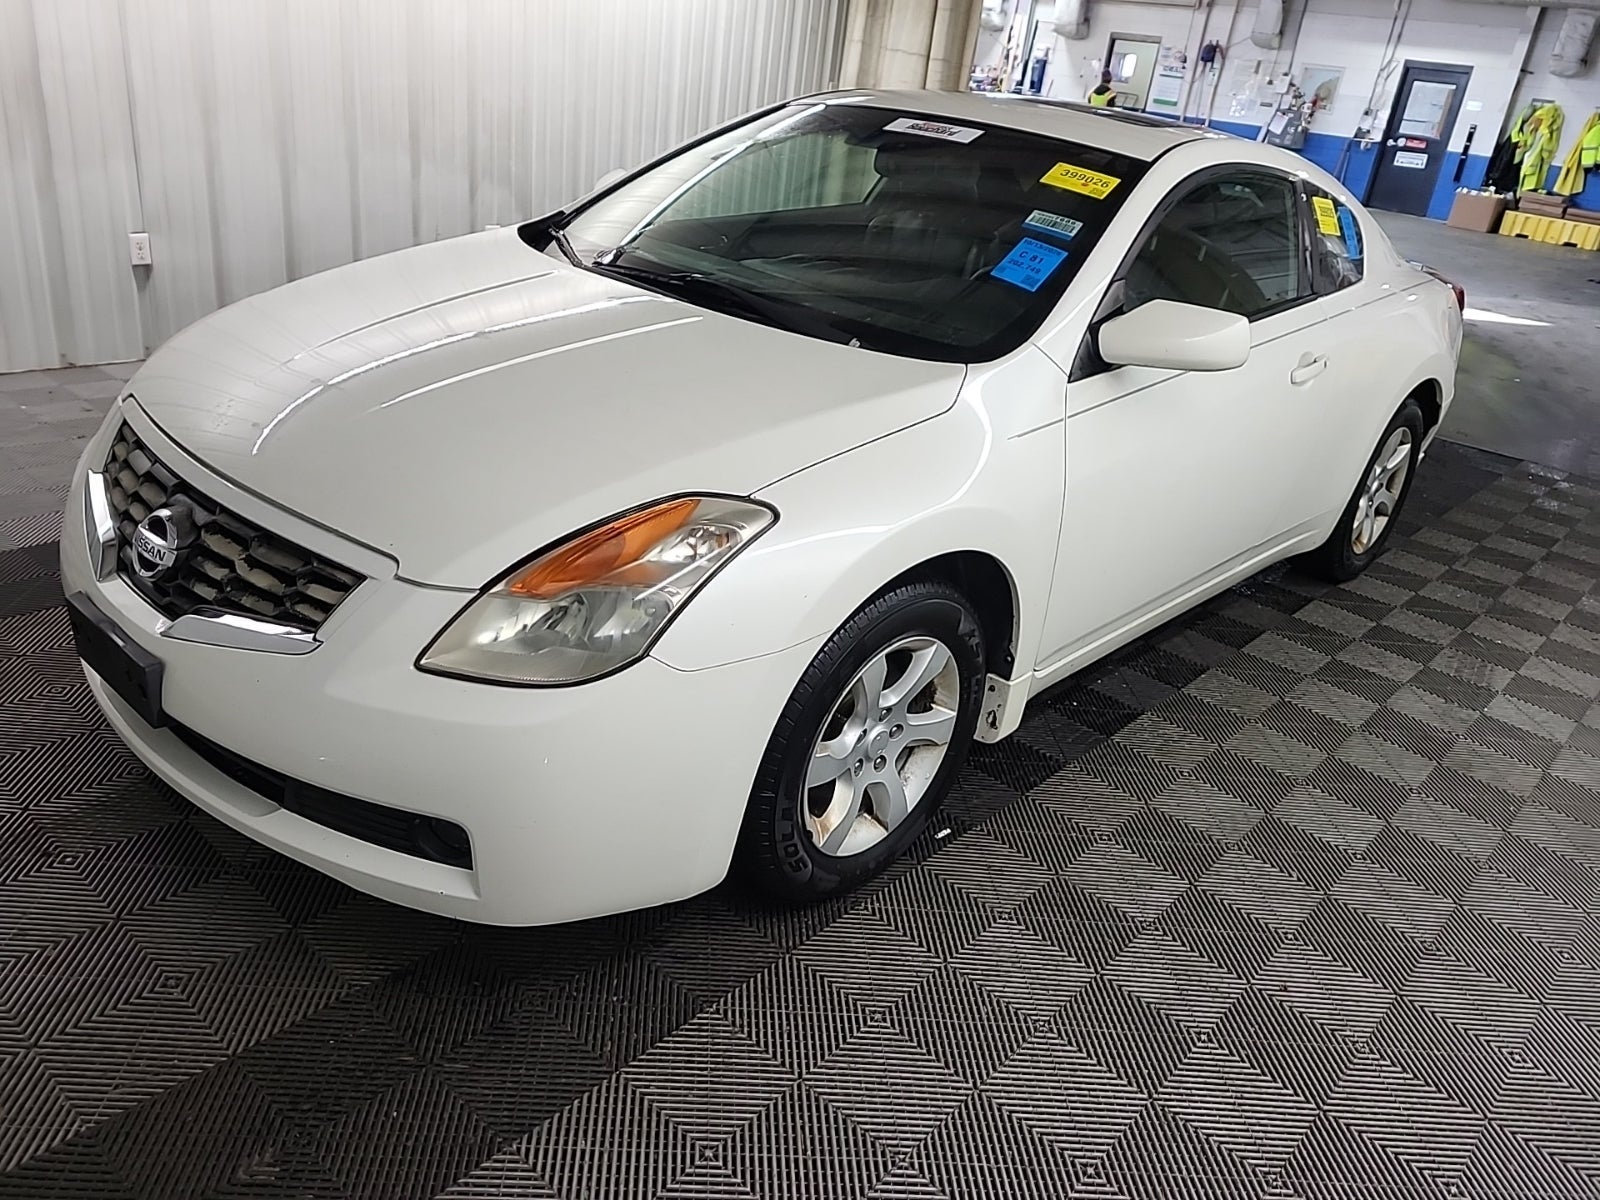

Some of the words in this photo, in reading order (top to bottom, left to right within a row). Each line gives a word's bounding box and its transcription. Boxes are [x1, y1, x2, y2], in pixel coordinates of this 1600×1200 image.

[1060, 169, 1111, 188] 399026
[1019, 251, 1027, 259] C
[1029, 254, 1045, 265] 81
